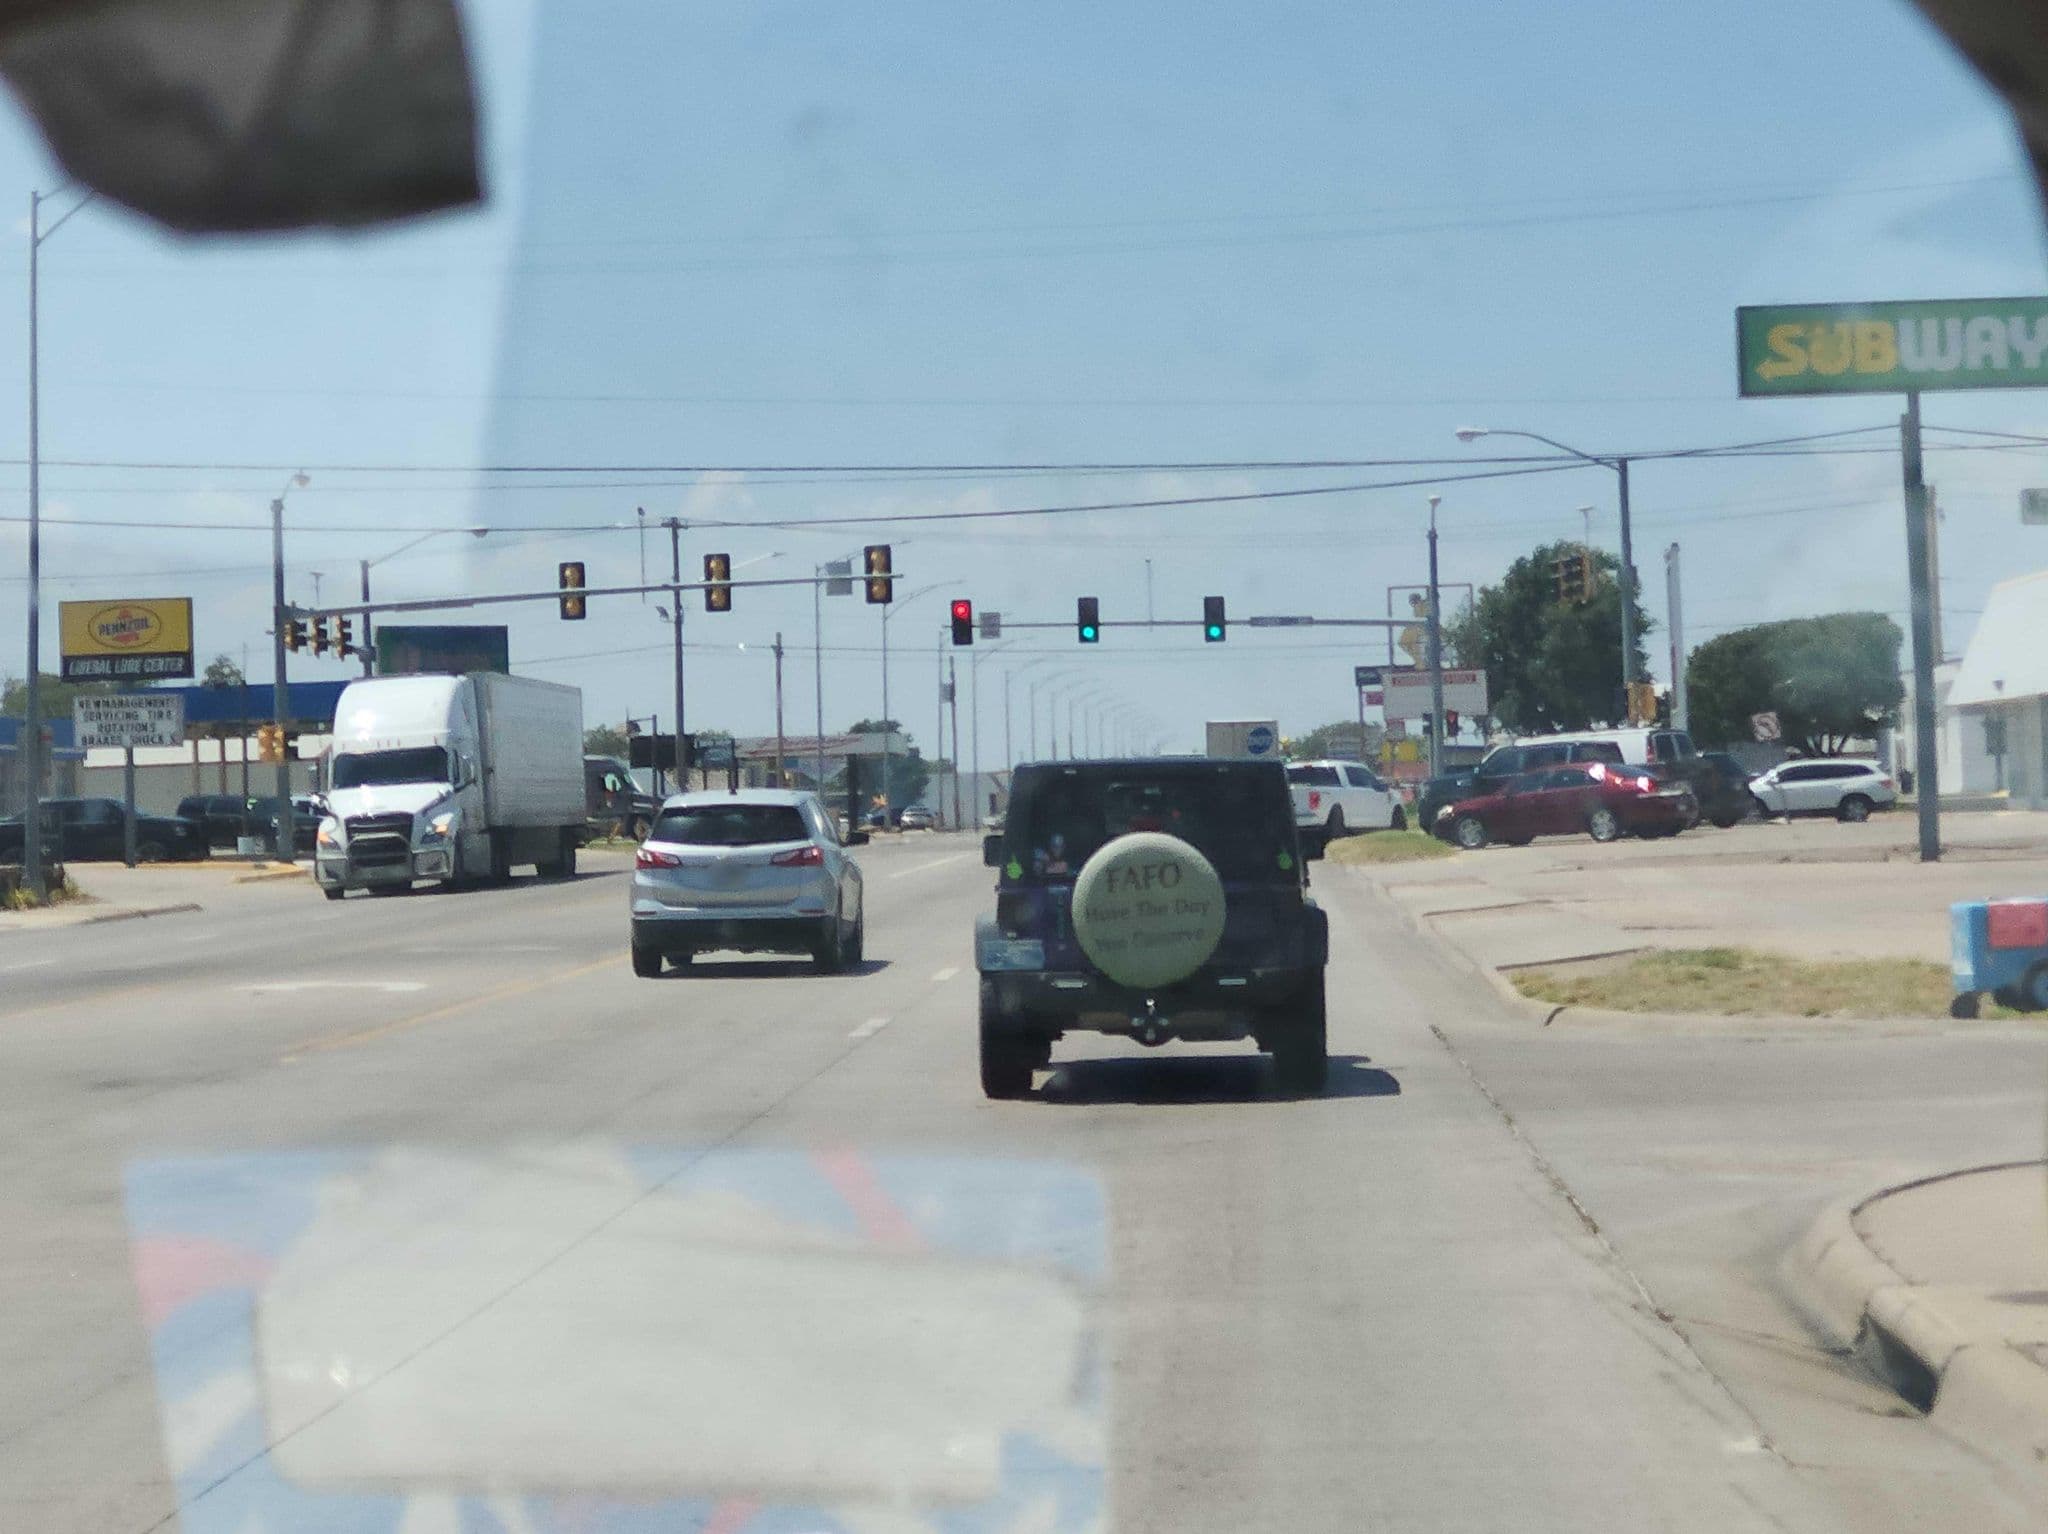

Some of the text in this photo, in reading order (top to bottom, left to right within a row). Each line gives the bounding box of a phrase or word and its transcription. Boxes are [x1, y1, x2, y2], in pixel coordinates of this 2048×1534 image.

[1757, 316, 2048, 383] SUBWAY
[144, 657, 184, 673] CENTER
[1105, 861, 1182, 893] FAFO
[1086, 898, 1210, 922] Have The Day
